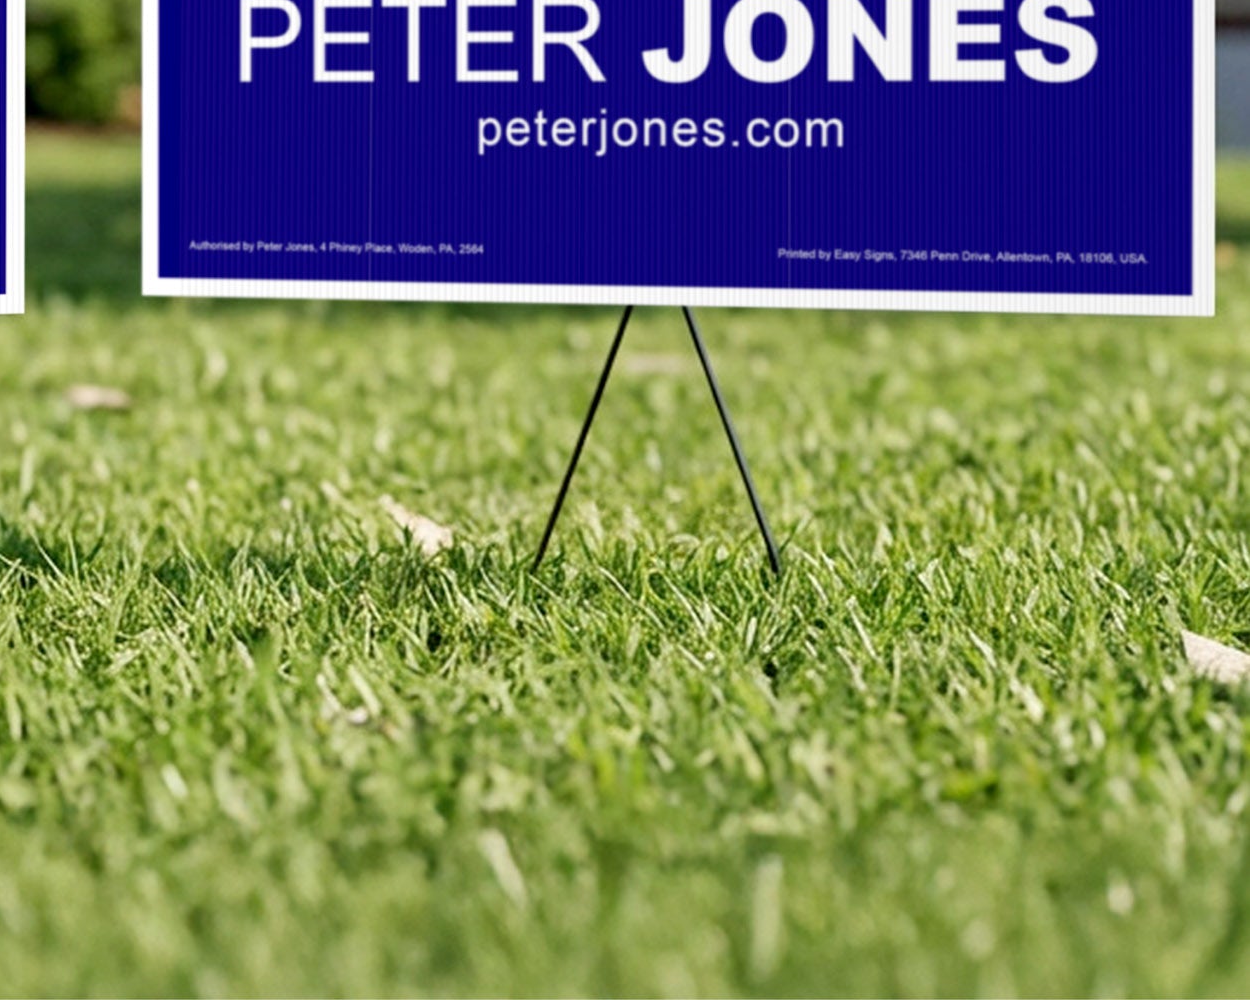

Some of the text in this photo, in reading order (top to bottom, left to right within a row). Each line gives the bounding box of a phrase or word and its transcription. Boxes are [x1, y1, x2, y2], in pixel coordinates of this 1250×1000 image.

[478, 108, 844, 156] peterjones.com
[189, 240, 241, 251] Authorised
[242, 241, 255, 253] by
[256, 240, 283, 251] Peter
[319, 242, 327, 252] 4
[328, 241, 363, 254] Phiney
[398, 243, 436, 254] Woden,
[459, 243, 484, 255] 2564
[777, 247, 817, 259] Printed
[818, 249, 832, 261] by
[833, 248, 861, 262] Easy
[863, 249, 897, 263] Signs,
[900, 249, 928, 261] 7346
[930, 250, 959, 261] Penn
